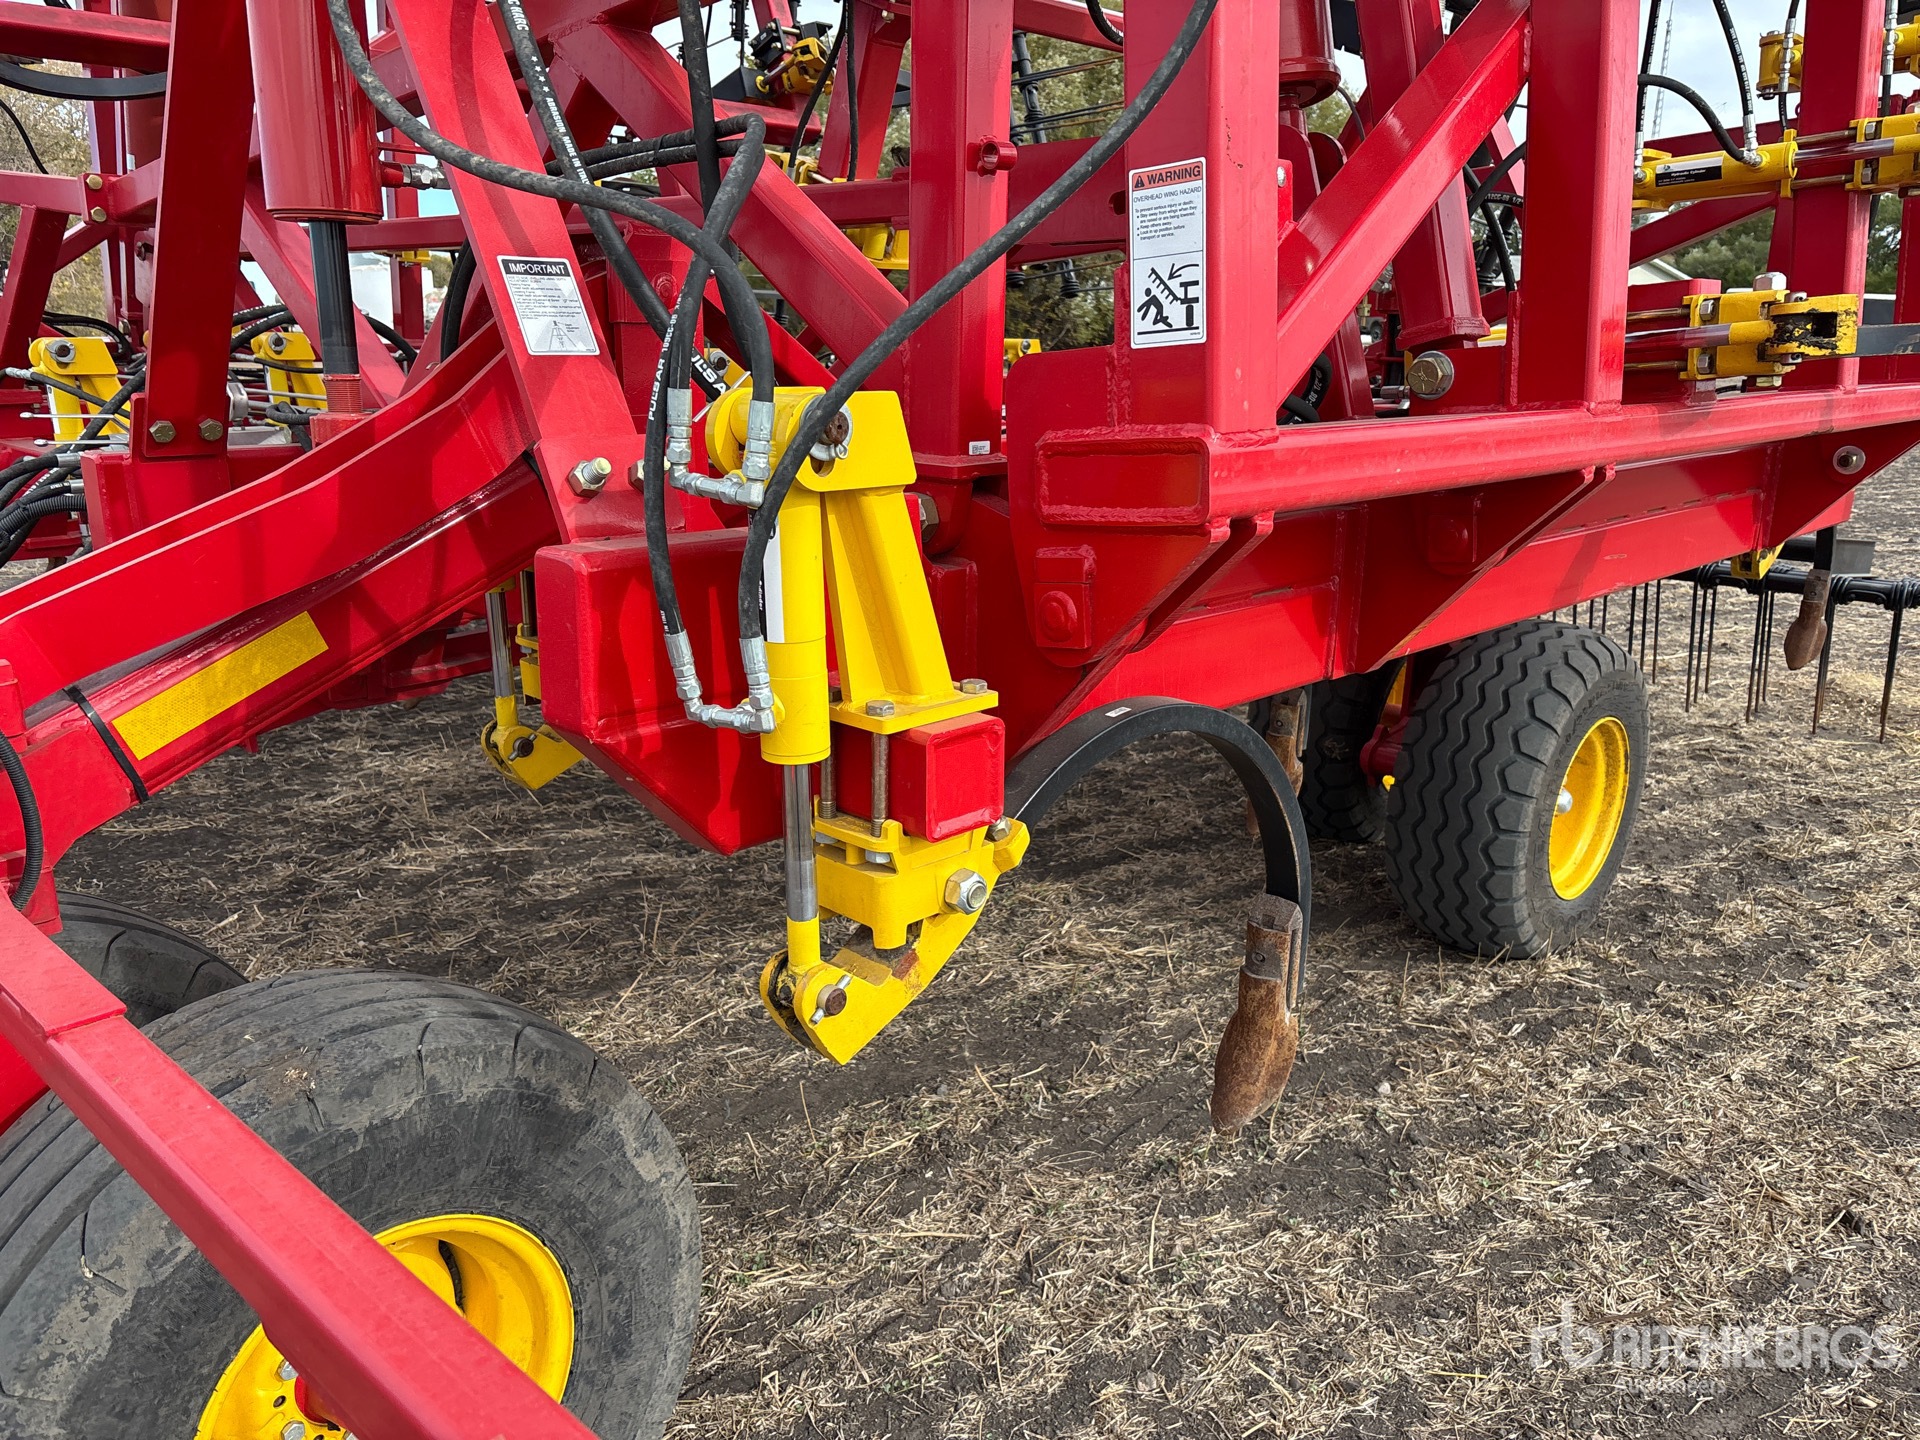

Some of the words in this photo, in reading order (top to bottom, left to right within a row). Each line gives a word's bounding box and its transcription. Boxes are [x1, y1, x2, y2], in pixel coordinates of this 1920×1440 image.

[510, 7, 530, 31] HARC
[546, 97, 567, 133] ABRASION
[562, 136, 578, 158] MADE
[572, 158, 582, 168] IN
[576, 168, 591, 185] ITALY
[1147, 165, 1201, 185] WARNING
[1133, 192, 1163, 203] OVERHEAD
[1164, 189, 1179, 199] WING
[1180, 186, 1202, 196] HAZARD
[508, 262, 566, 275] IMPORTANT
[648, 358, 666, 421] PULSAR
